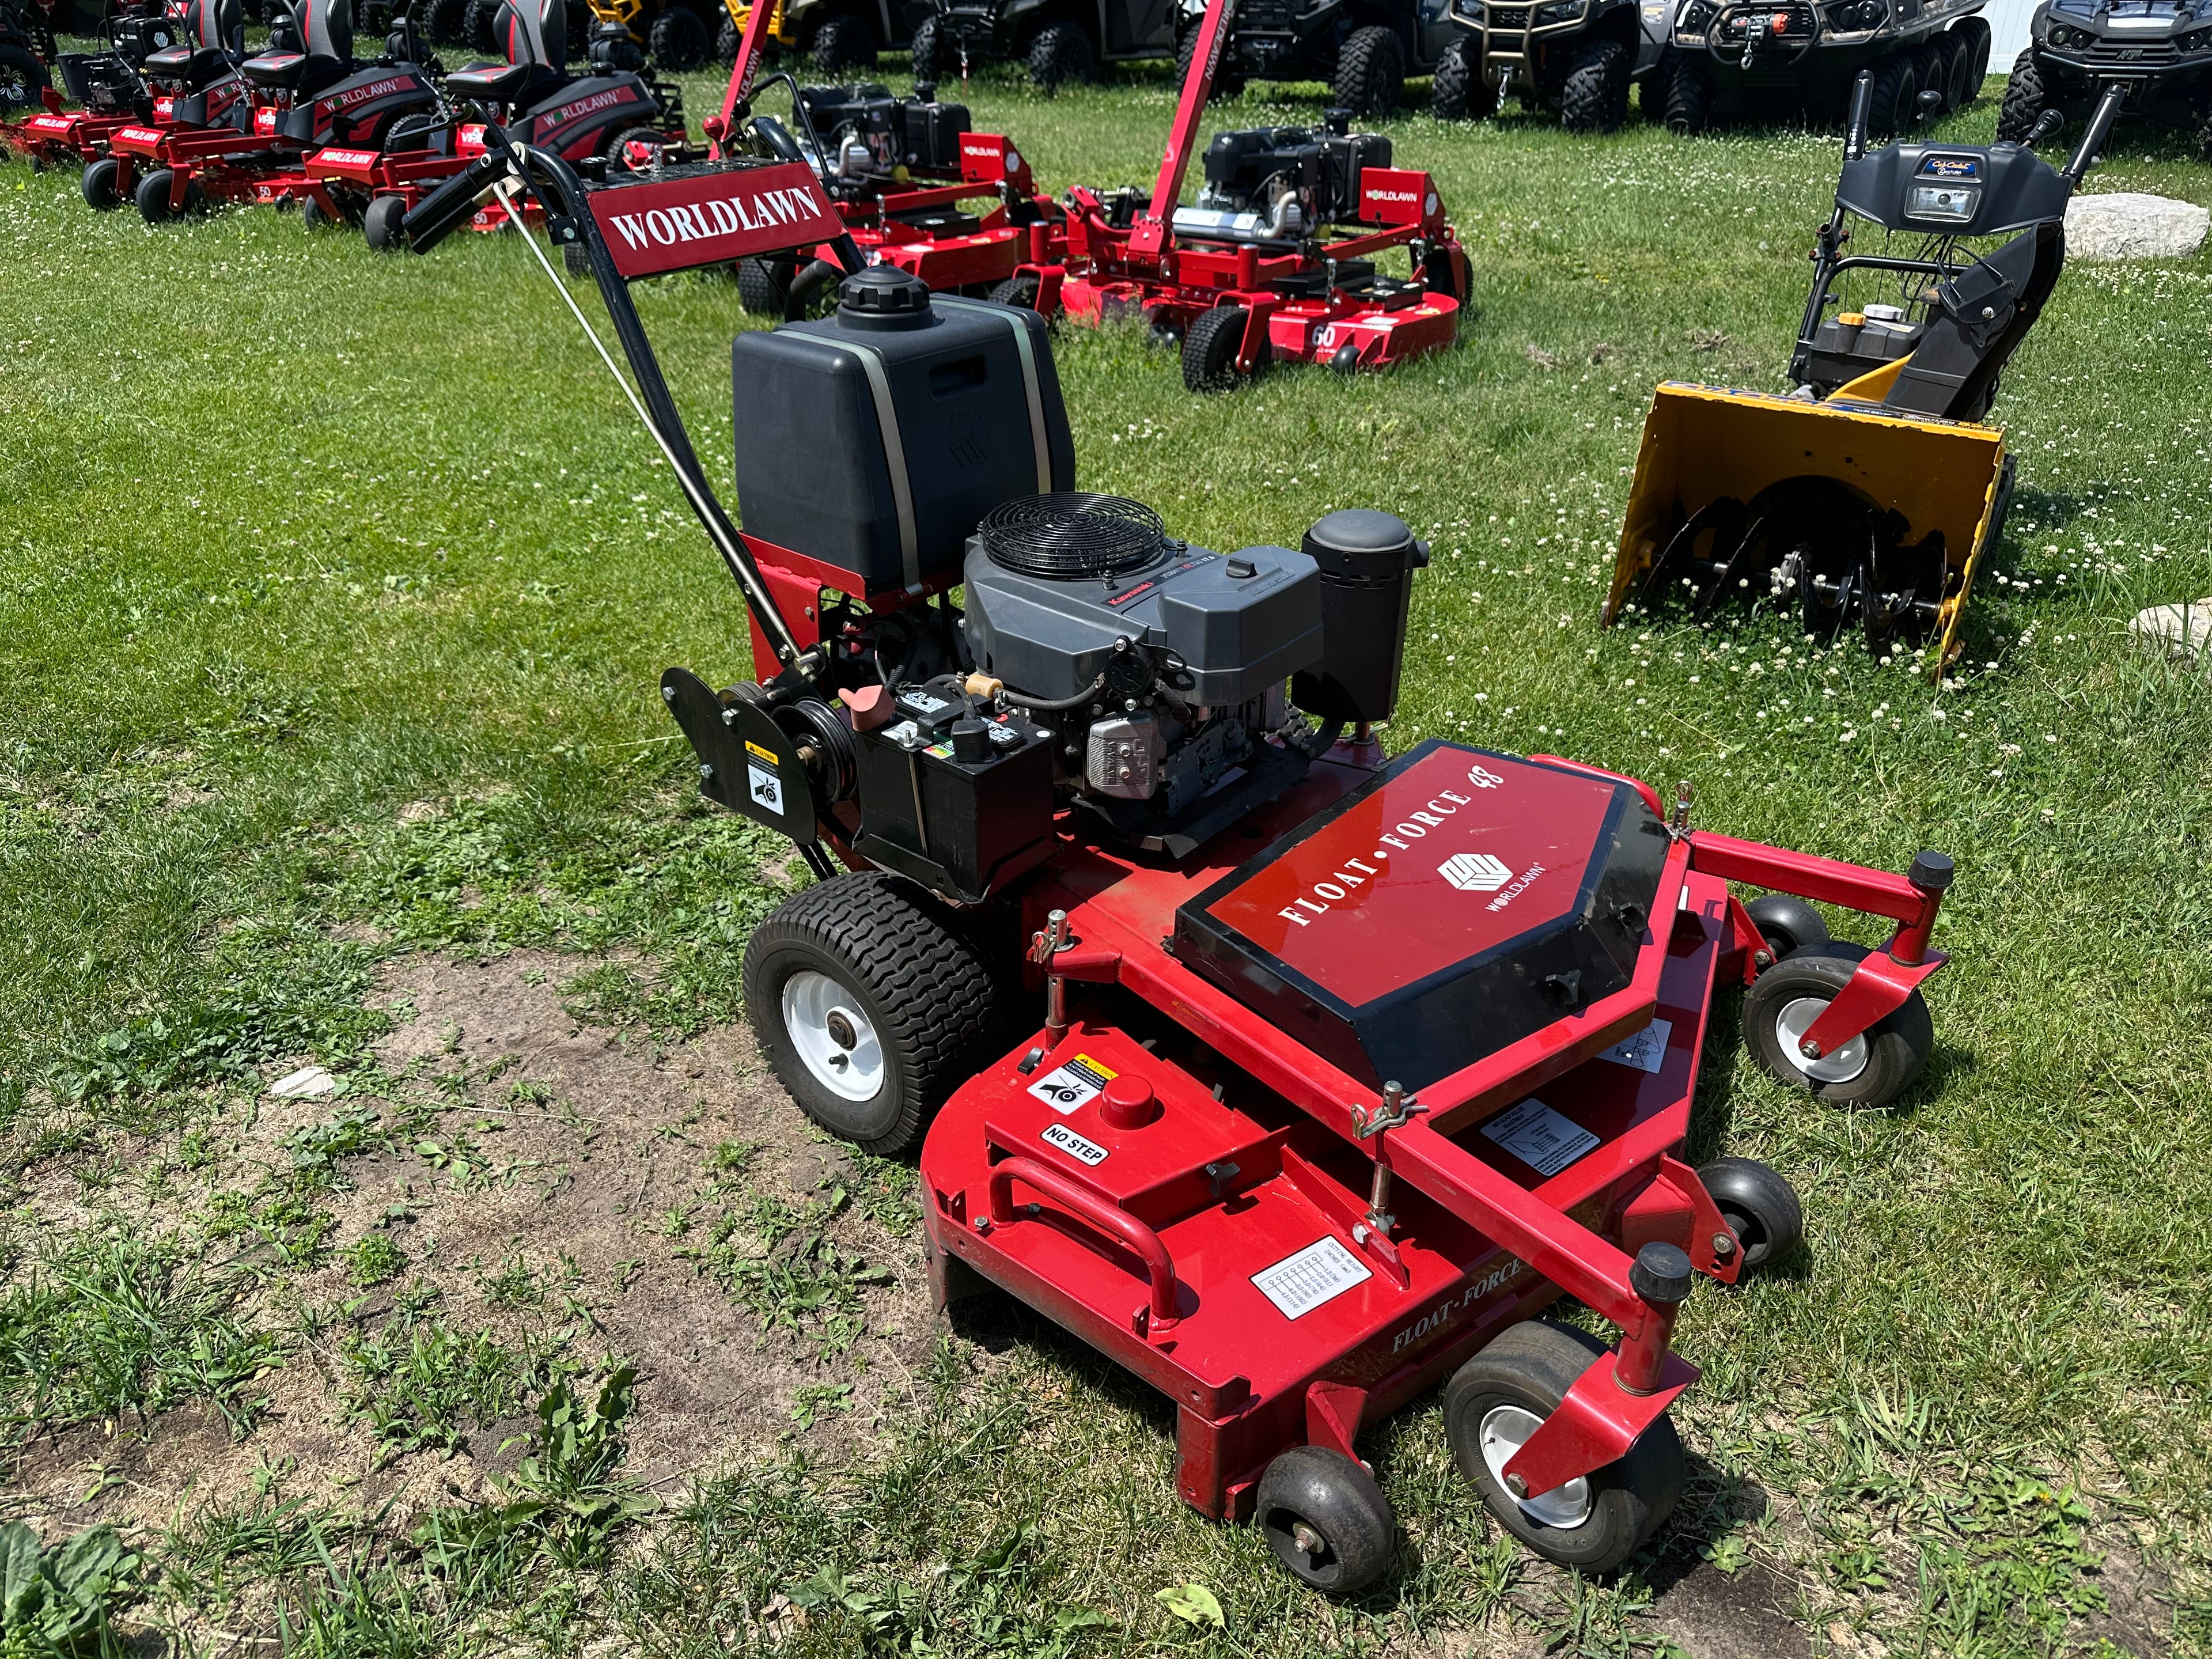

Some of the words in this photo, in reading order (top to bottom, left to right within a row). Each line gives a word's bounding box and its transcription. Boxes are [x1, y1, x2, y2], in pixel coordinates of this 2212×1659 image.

[323, 81, 397, 112] WORLDLAWN
[543, 90, 619, 127] WORLDLAWN
[120, 128, 160, 142] WORLDLAWN
[320, 151, 372, 164] WORLDLAWN
[259, 186, 271, 197] 50
[1366, 189, 1418, 202] WORLDLAWN
[609, 185, 821, 252] WORLDLAWN
[1312, 325, 1336, 347] 60
[1108, 581, 1154, 605] Kawasaki
[756, 749, 775, 761] CAUTION
[1467, 765, 1505, 789] 48
[1485, 863, 1547, 912] WORLDLAWN
[1090, 1063, 1113, 1078] CAUTION
[1046, 1128, 1069, 1142] NO
[1067, 1139, 1103, 1160] STEP
[1324, 1249, 1341, 1264] INCHES
[1328, 1242, 1347, 1259] CUTTING
[1345, 1257, 1363, 1274] HEIGHT
